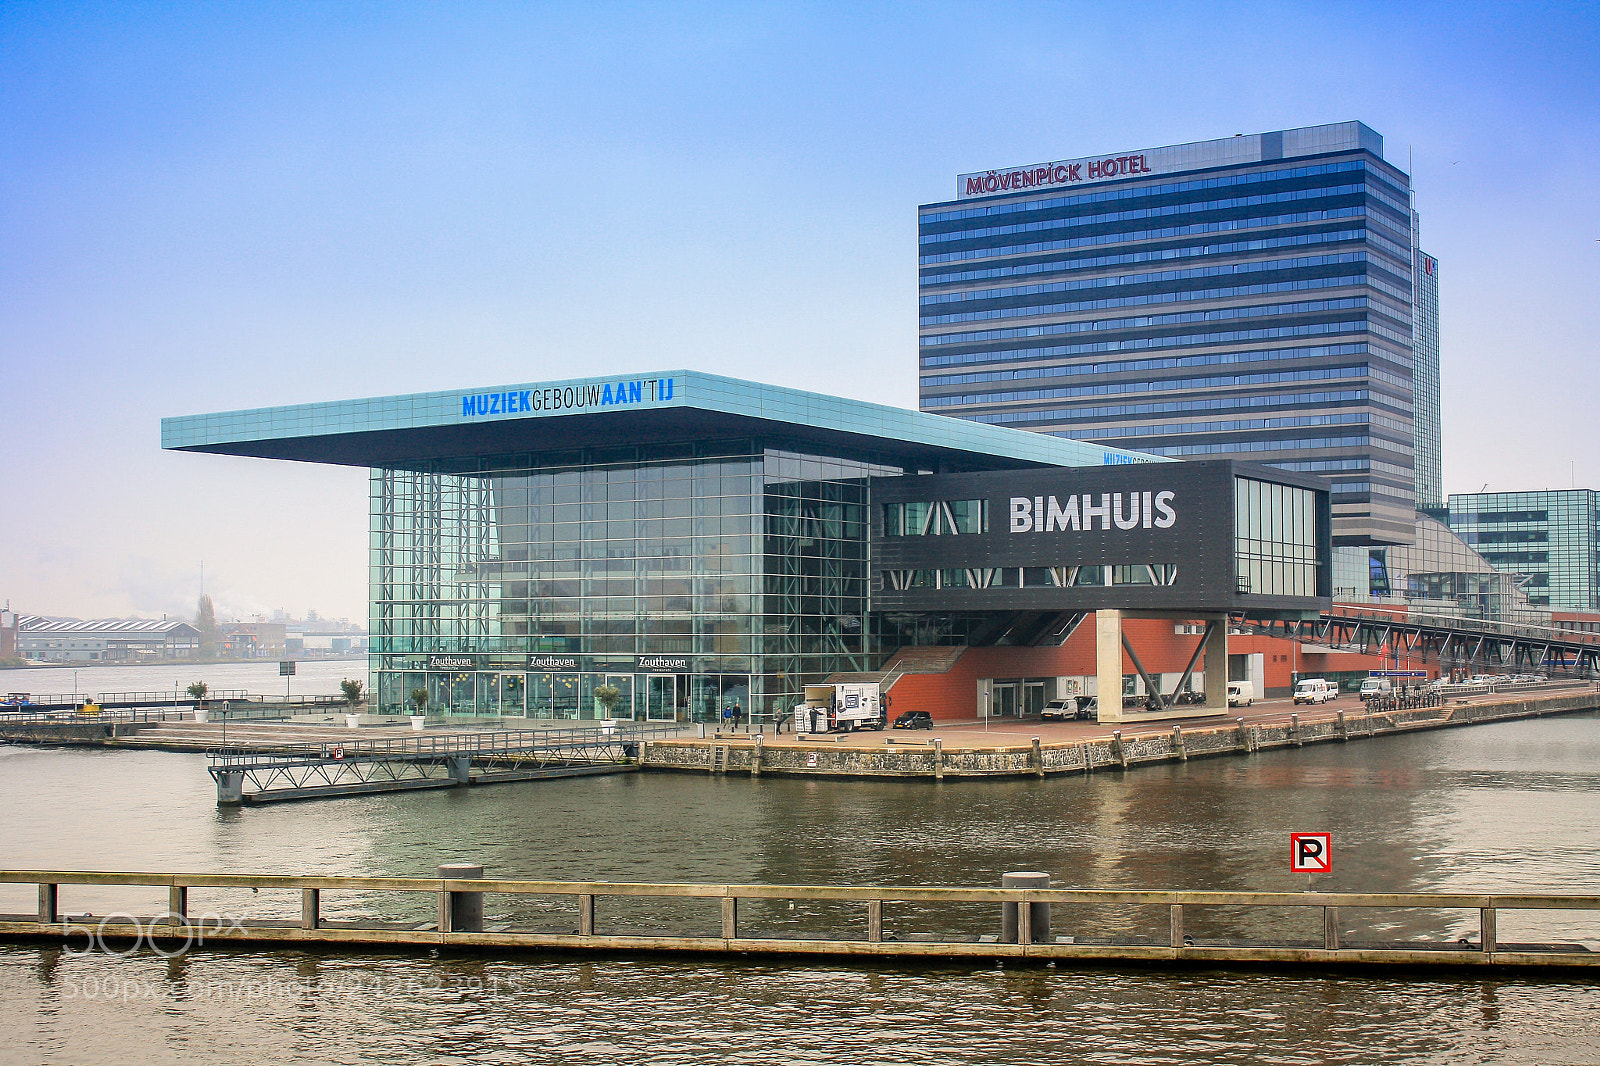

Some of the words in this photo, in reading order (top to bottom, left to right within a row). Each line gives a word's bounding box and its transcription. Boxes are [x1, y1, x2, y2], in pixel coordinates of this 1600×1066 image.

[1088, 155, 1151, 179] HOTEL
[1010, 491, 1176, 533] BIMHUIS
[430, 656, 472, 667] Zouthaven
[530, 656, 576, 667] Zouthaven
[638, 656, 687, 668] Zouthaven
[1299, 839, 1323, 866] P
